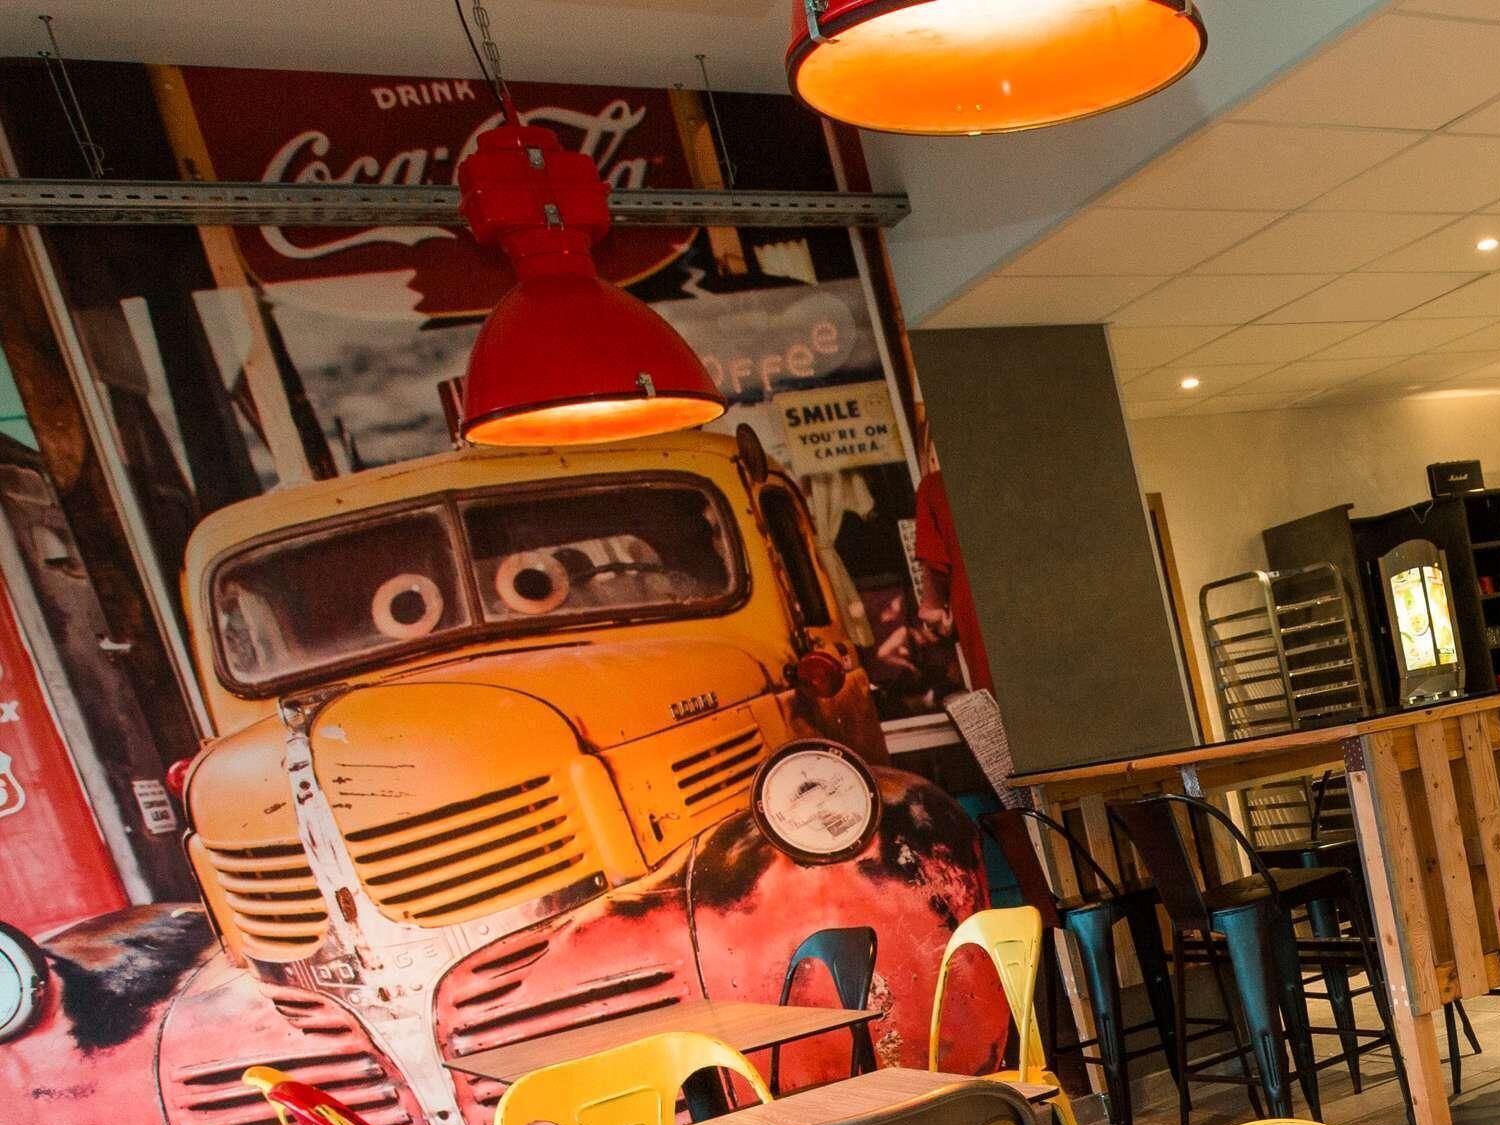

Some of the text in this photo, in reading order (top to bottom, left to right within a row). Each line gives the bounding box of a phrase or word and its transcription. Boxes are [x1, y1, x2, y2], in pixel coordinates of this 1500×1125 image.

[371, 79, 476, 111] DRINK
[784, 400, 861, 428] SMILE
[863, 423, 888, 438] ON
[814, 441, 880, 460] CAMERA
